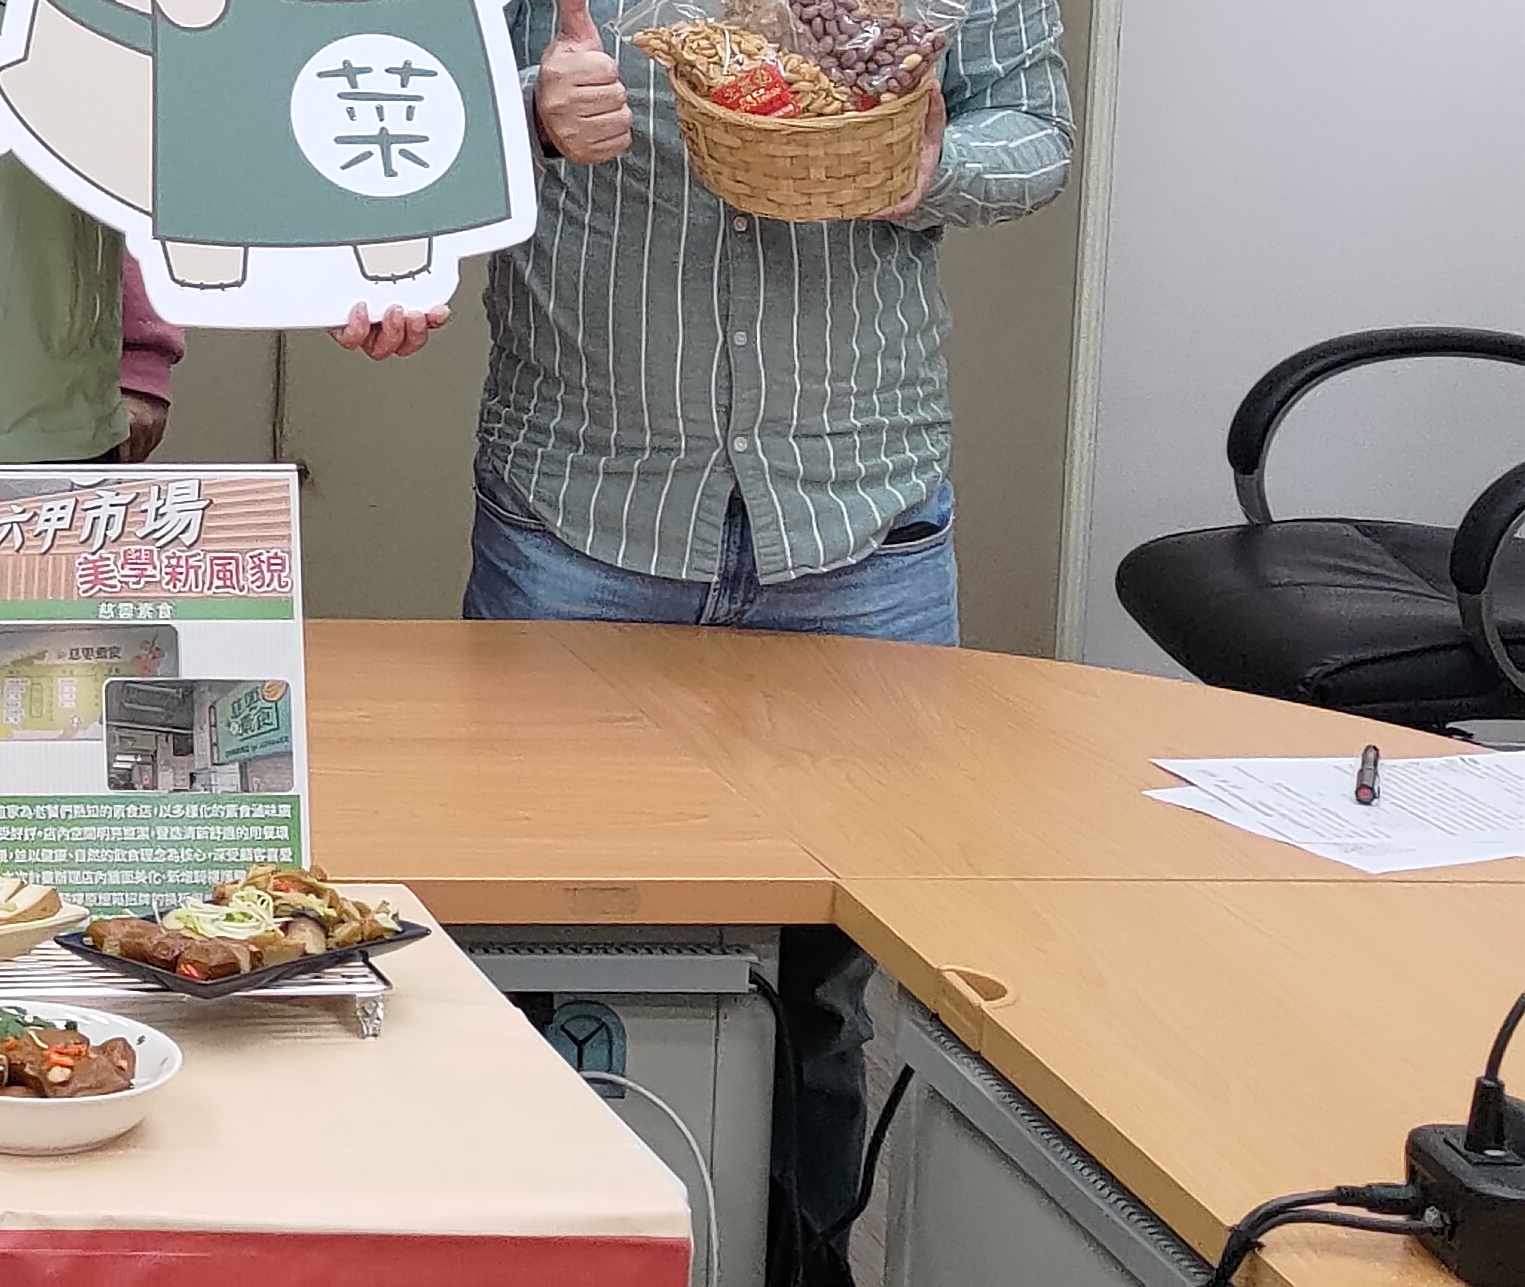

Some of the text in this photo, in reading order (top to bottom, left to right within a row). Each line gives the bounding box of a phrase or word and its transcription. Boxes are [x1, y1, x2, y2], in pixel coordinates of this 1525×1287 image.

[315, 59, 439, 178] 菜
[77, 547, 292, 596] 美學新風貌
